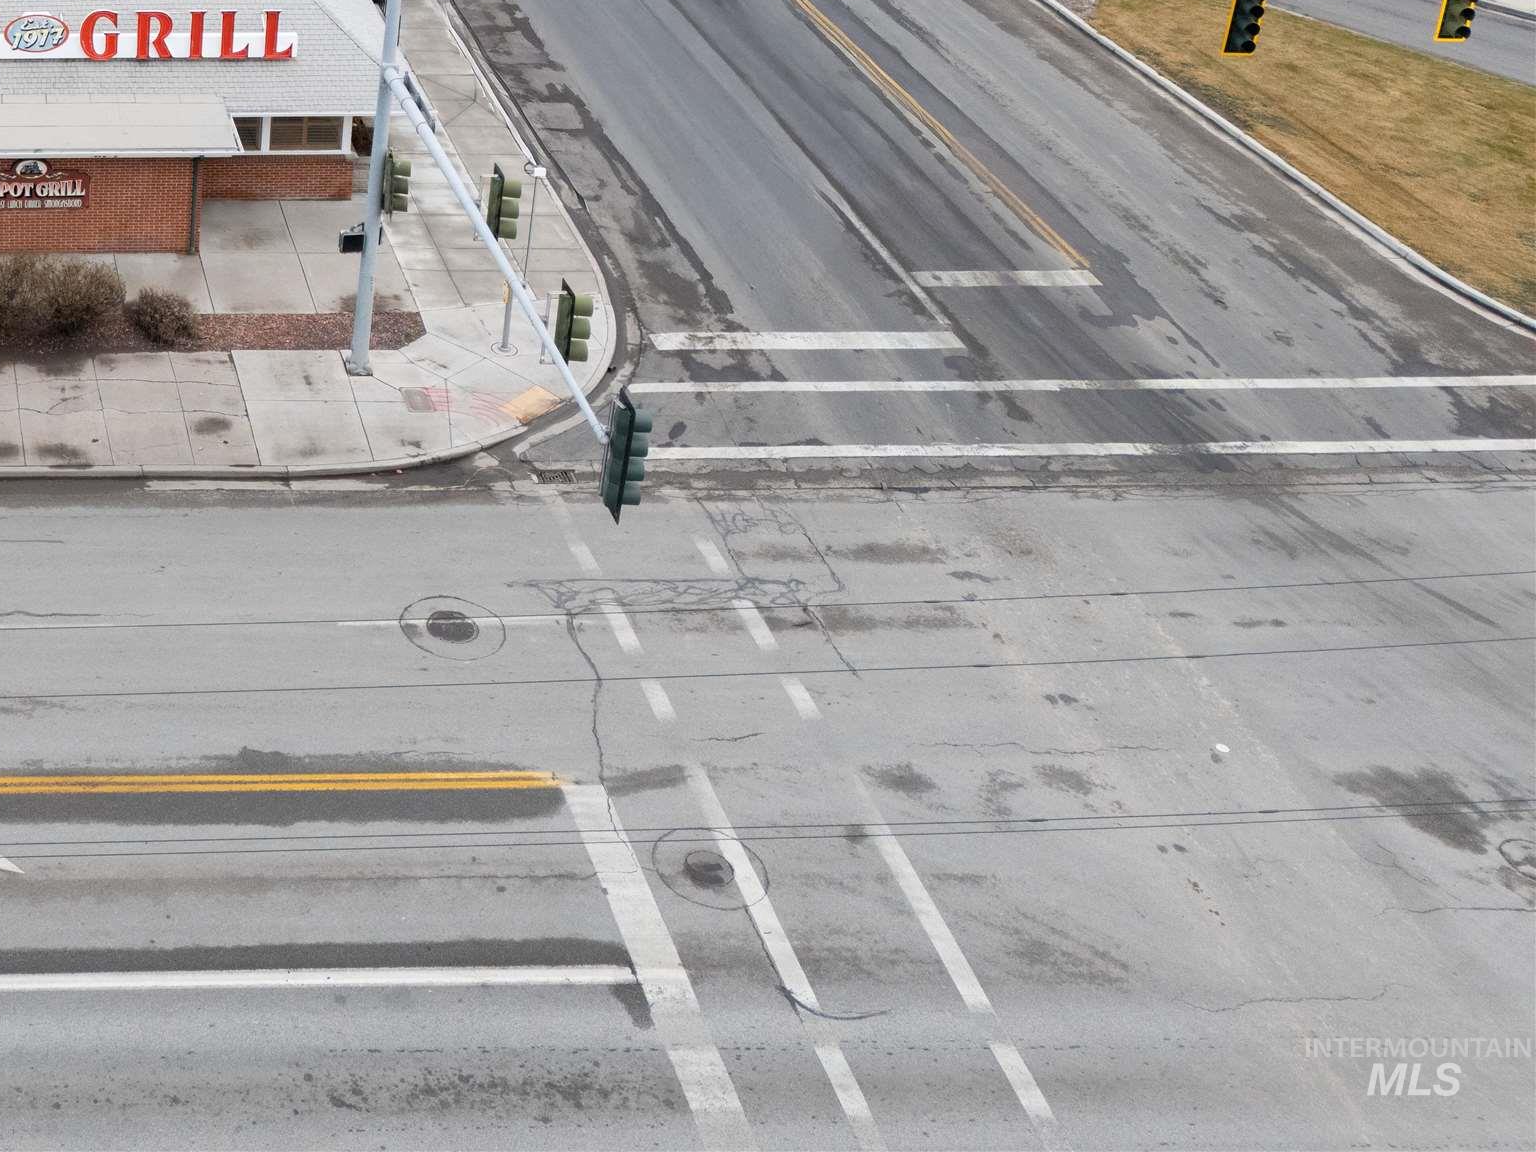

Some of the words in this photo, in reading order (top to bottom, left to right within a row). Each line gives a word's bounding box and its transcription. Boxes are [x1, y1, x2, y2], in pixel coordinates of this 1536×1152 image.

[12, 27, 66, 51] 1917
[80, 9, 294, 61] GRILL
[35, 178, 86, 197] GRILL
